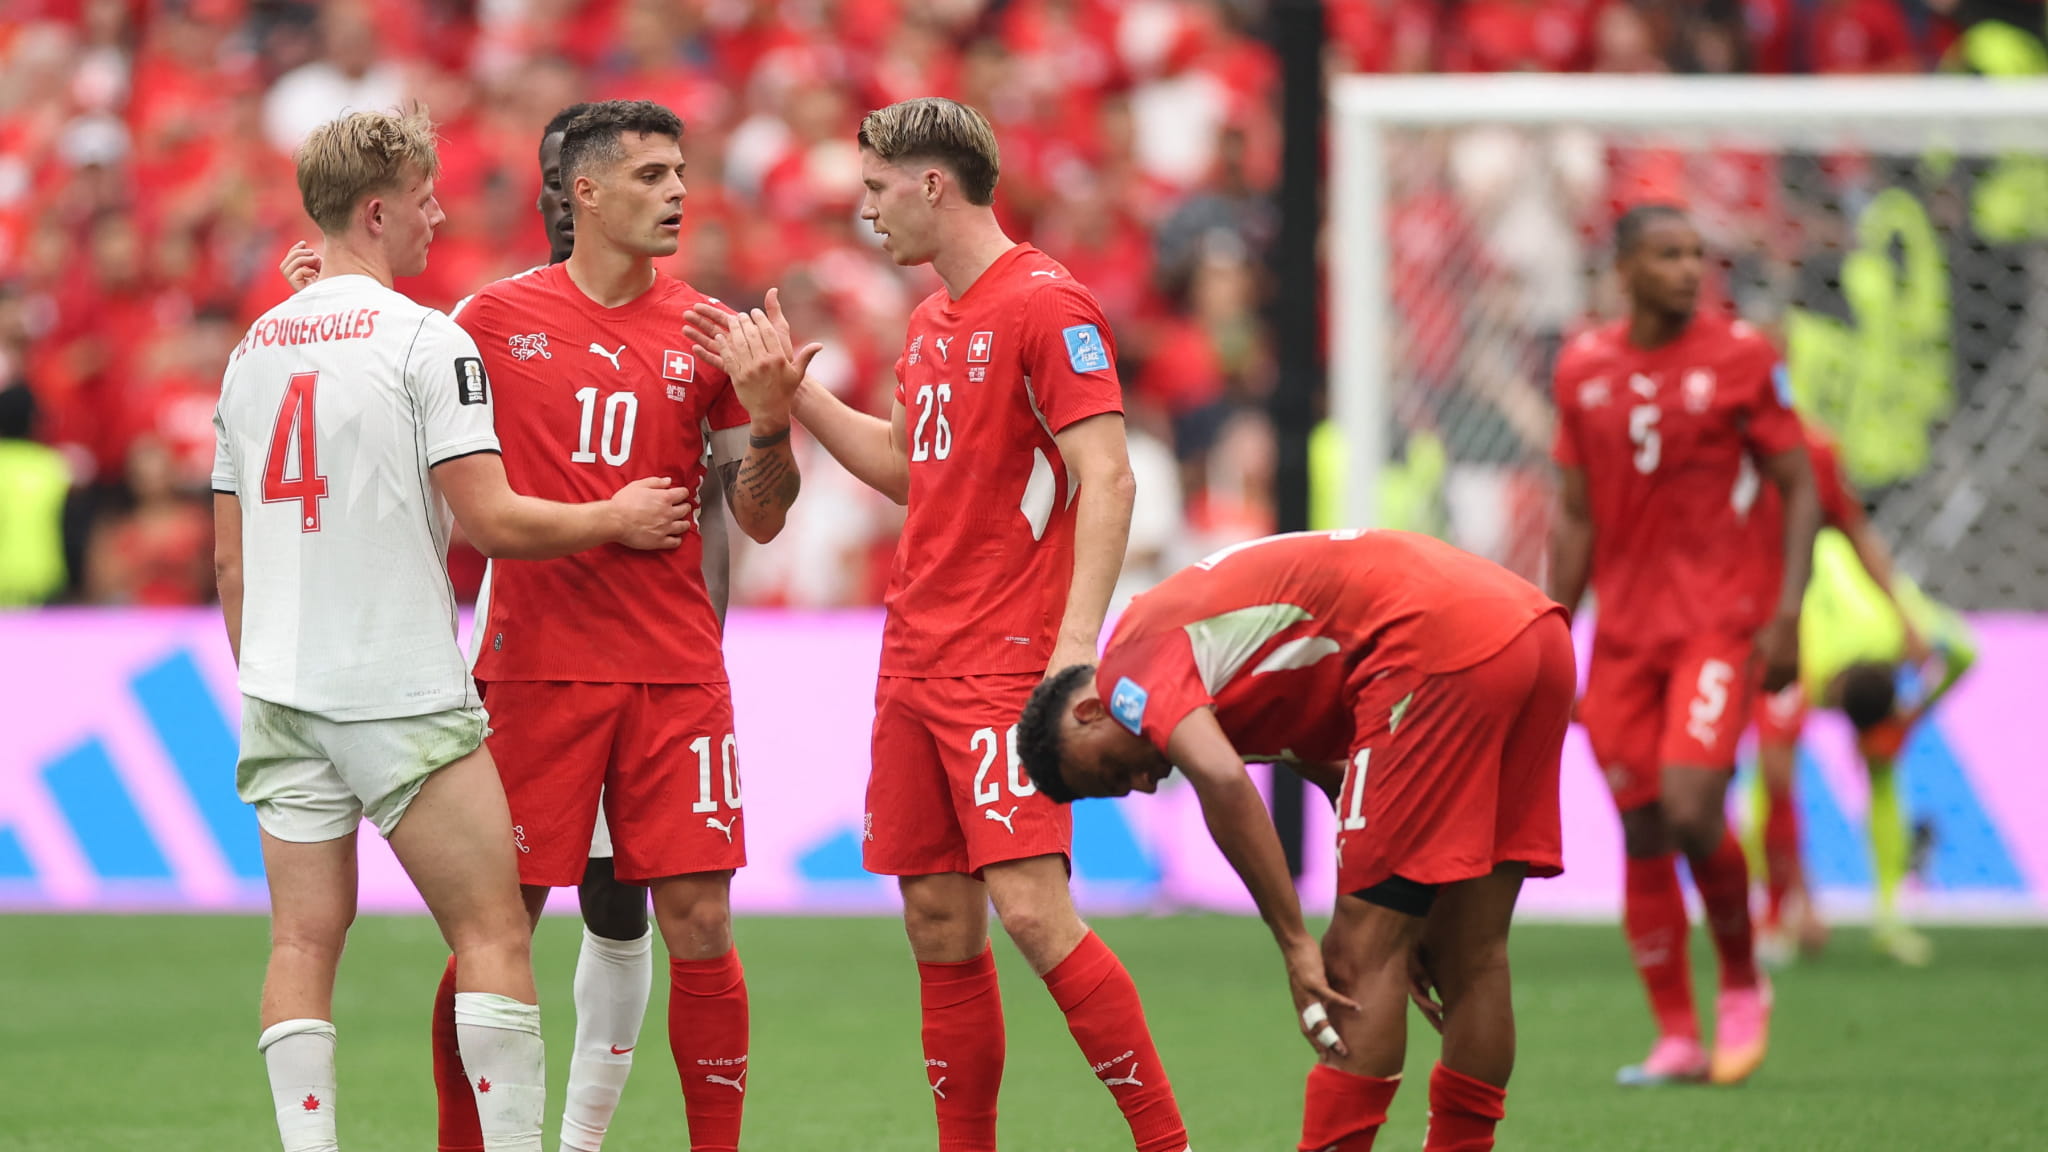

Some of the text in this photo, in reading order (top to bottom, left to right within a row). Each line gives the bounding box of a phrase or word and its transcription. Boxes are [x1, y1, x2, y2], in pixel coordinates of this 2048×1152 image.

[252, 308, 381, 349] FOUGEROLLES
[261, 370, 329, 533] 4
[571, 386, 639, 467] 10
[912, 383, 952, 462] 26
[1629, 404, 1662, 474] 5
[1689, 657, 1735, 723] 5
[688, 733, 742, 813] 10
